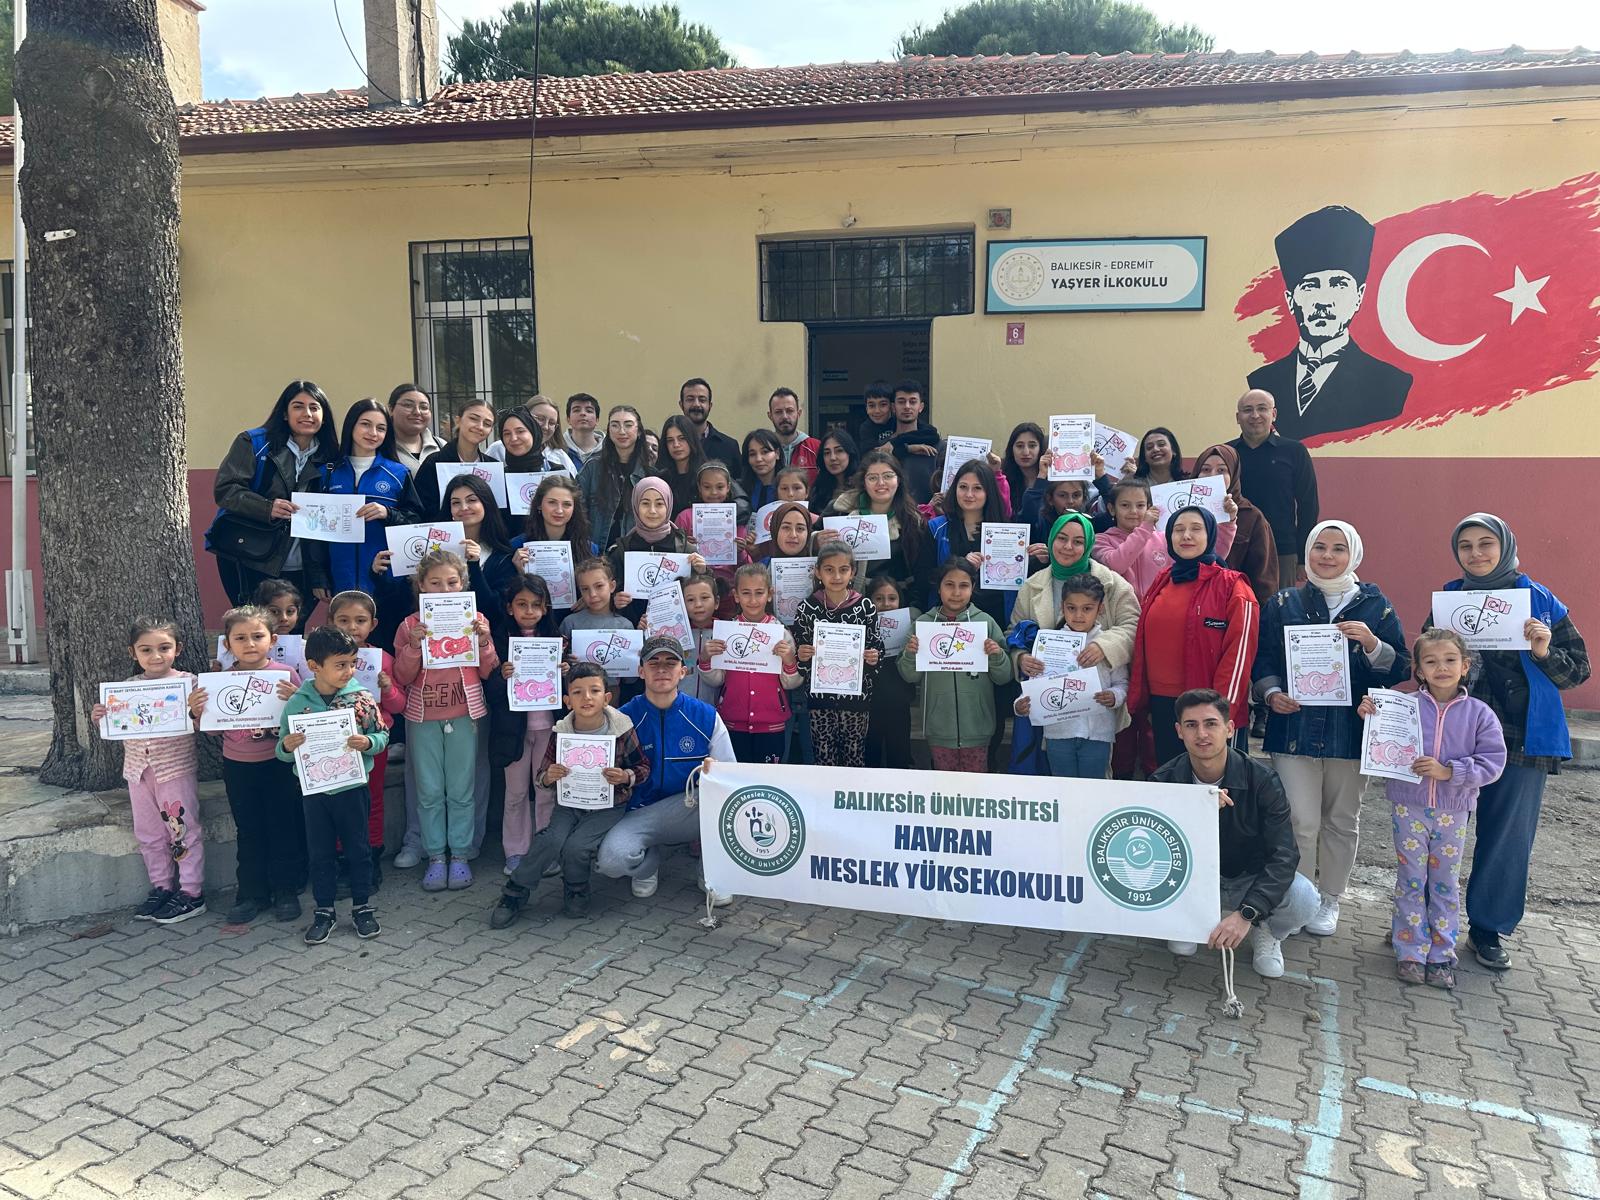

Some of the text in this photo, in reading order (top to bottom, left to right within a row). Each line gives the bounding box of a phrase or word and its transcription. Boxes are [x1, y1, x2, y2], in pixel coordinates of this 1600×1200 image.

[1051, 260, 1101, 271] BALIKESİR
[1111, 259, 1154, 269] EDREMİT
[1051, 275, 1168, 290] YAŞYER İLKOKULU
[1012, 327, 1019, 339] 6
[727, 792, 797, 827] Havran Meslek Yüksekokulu
[834, 790, 1059, 823] BALIKESİR ÜNİVERSİTESİ
[727, 832, 798, 868] BALIKESİR ÜNİVERSİTESİ
[894, 824, 992, 857] HAVRAN
[1097, 815, 1183, 871] BALIKESİR ÜNİVERSİTESİ
[810, 855, 1084, 905] MESLEK YÜKSEKOKULU
[1127, 891, 1152, 902] 1992
